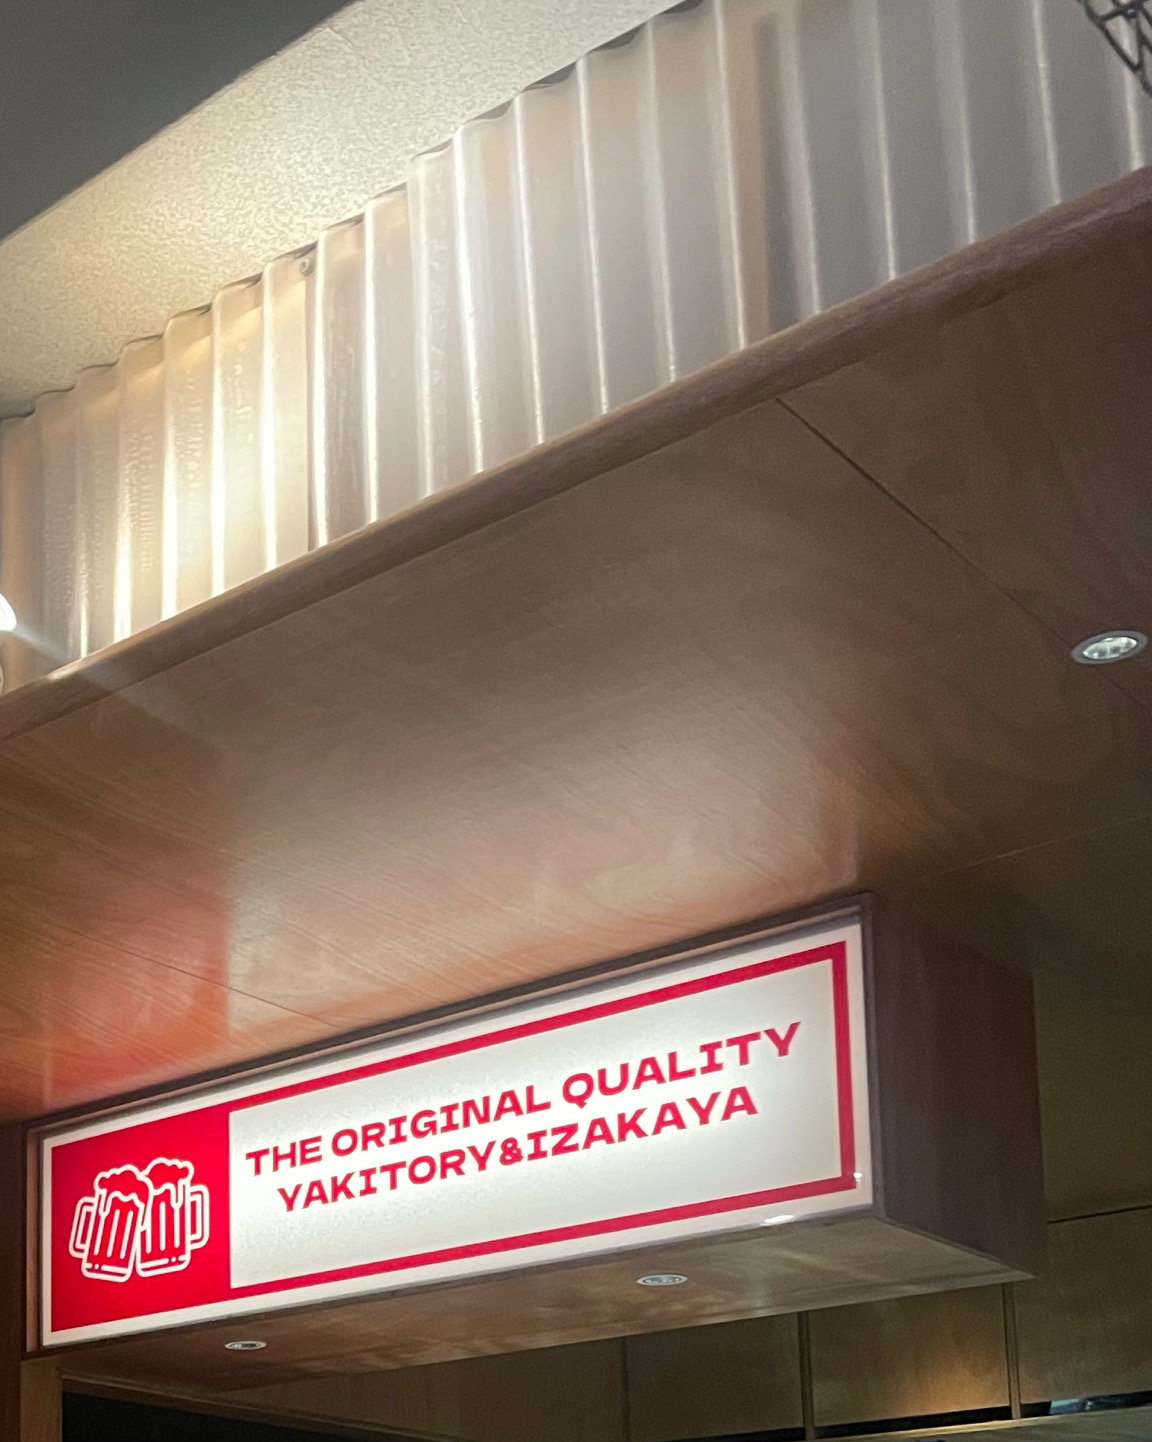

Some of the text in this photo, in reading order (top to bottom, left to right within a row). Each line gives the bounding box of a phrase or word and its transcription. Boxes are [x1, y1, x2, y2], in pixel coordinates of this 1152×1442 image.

[246, 1021, 802, 1176] THE ORIGINAL QUALITY
[277, 1086, 759, 1213] YAKITORY&IZAKAYA
